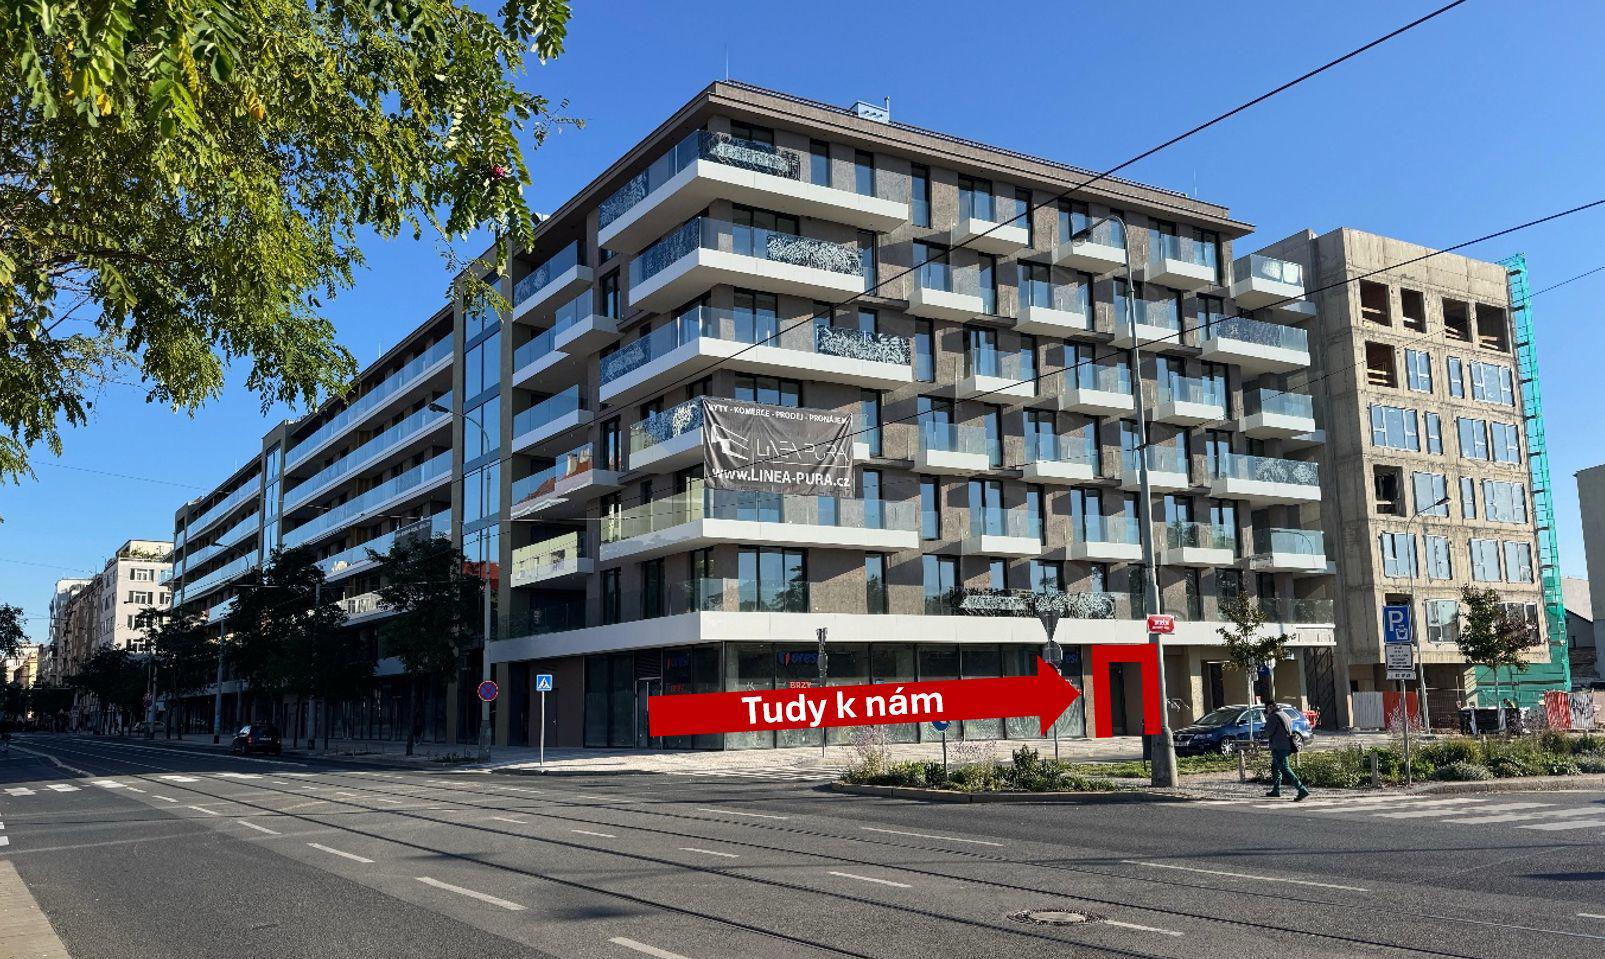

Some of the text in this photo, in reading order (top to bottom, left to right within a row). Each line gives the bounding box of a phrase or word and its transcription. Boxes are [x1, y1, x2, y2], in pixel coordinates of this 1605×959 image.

[775, 411, 804, 421] PRODEJ
[712, 468, 850, 487] www.LINEA-PURA.cz
[1388, 610, 1404, 632] P
